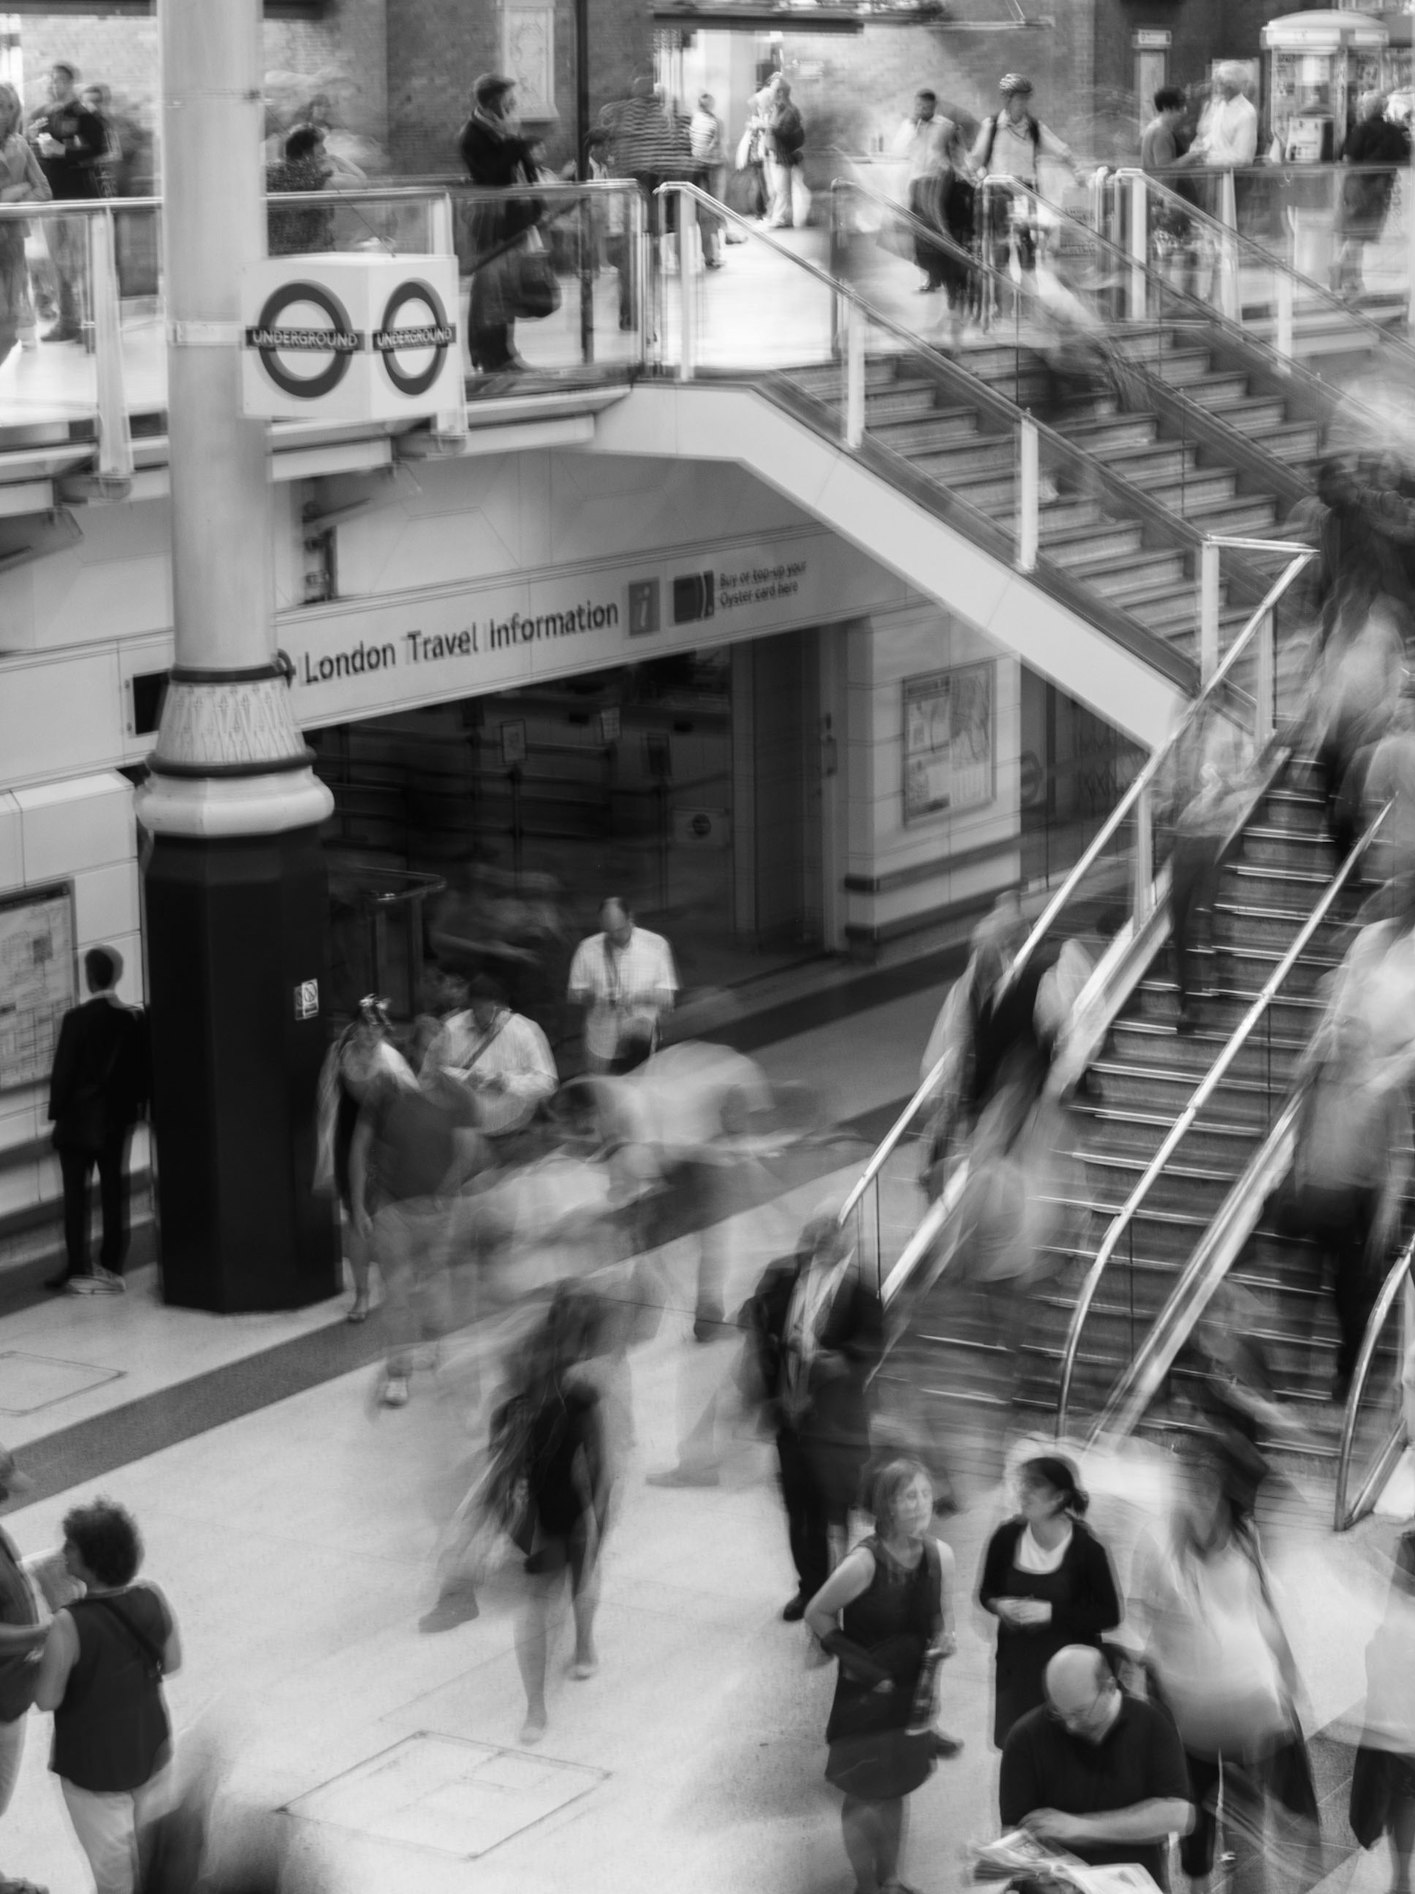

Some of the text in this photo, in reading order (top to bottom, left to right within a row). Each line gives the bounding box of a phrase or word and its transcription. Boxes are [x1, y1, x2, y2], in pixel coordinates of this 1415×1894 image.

[252, 328, 359, 347] UNDERGROUND
[376, 326, 453, 347] UNDERGROUND
[719, 572, 738, 589] Buy
[752, 565, 786, 583] top-up
[787, 560, 807, 577] your
[719, 580, 799, 608] Oyster card here
[304, 600, 619, 685] London Travel Information
